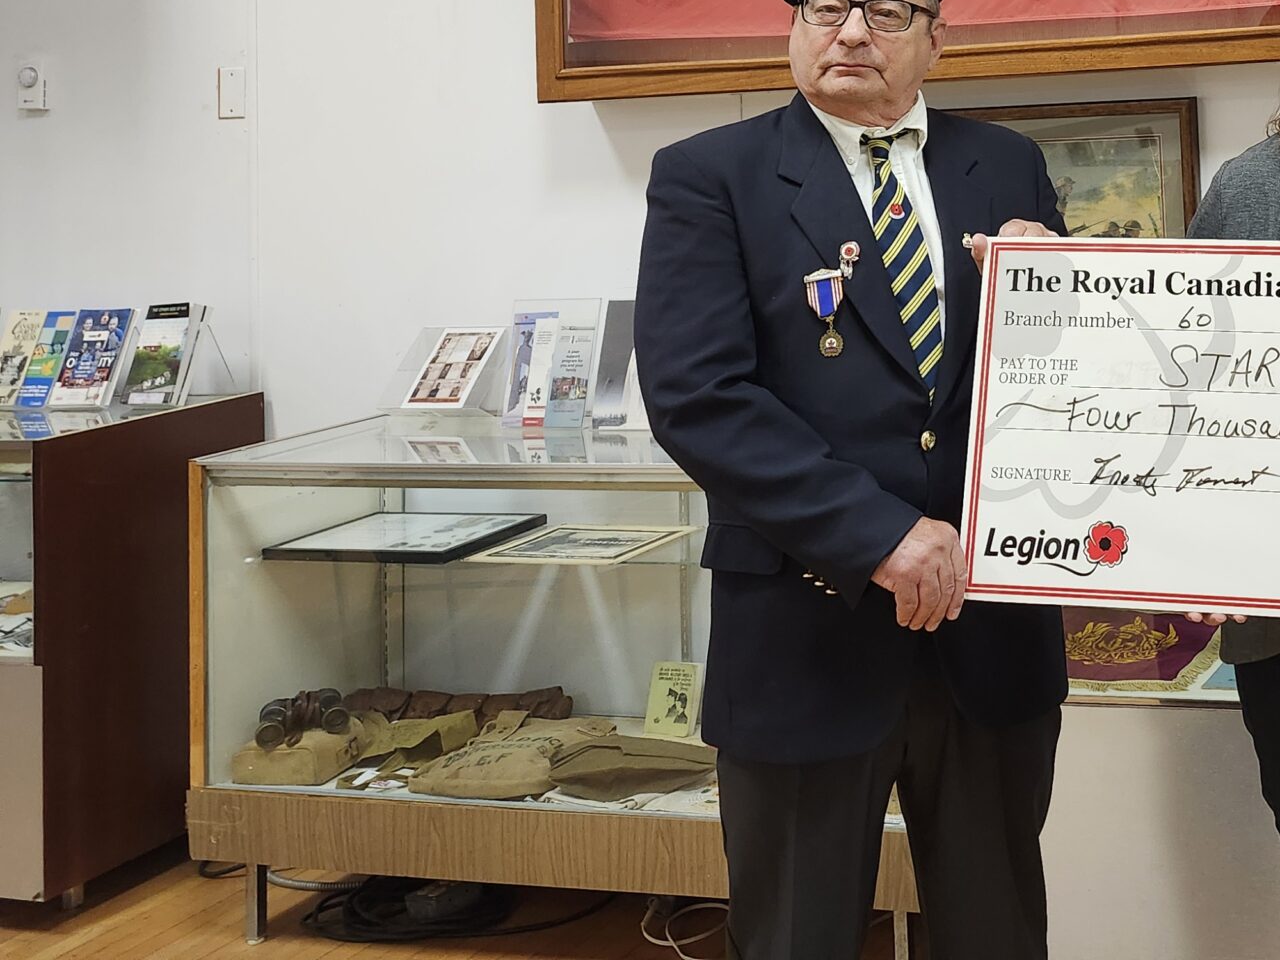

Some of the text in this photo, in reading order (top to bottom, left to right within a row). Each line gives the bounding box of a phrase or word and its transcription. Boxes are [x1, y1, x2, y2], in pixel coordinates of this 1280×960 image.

[1006, 267, 1061, 293] The
[1070, 269, 1156, 300] Royal
[1004, 310, 1134, 328] Branch number
[1178, 306, 1212, 329] 60
[1000, 358, 1078, 372] PAY TO THE
[999, 372, 1069, 385] ORDER OF
[1067, 394, 1142, 431] Four
[990, 466, 1072, 481] SIGNATURE
[984, 528, 1081, 565] Legion
